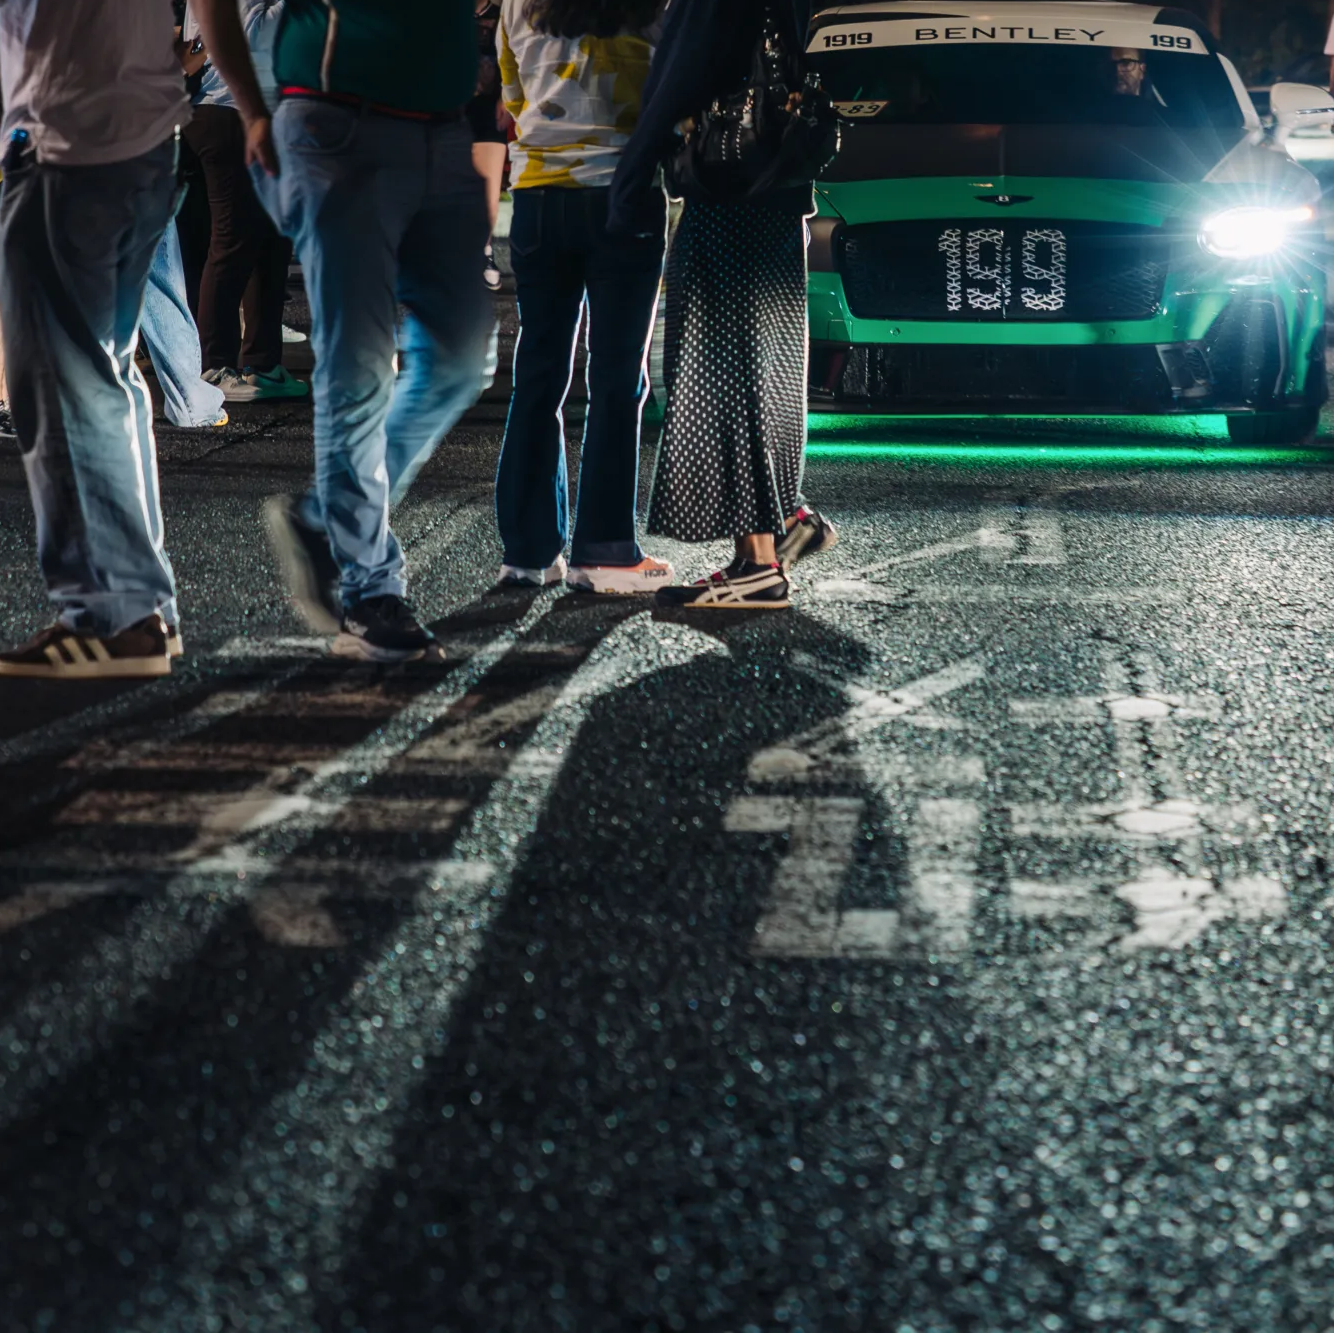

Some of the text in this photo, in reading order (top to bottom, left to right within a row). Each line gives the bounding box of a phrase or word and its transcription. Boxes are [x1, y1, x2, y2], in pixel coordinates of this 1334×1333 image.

[823, 32, 873, 48] 1919
[915, 26, 1105, 42] BENTLEY
[1149, 34, 1192, 49] 199
[938, 228, 1067, 312] 199
